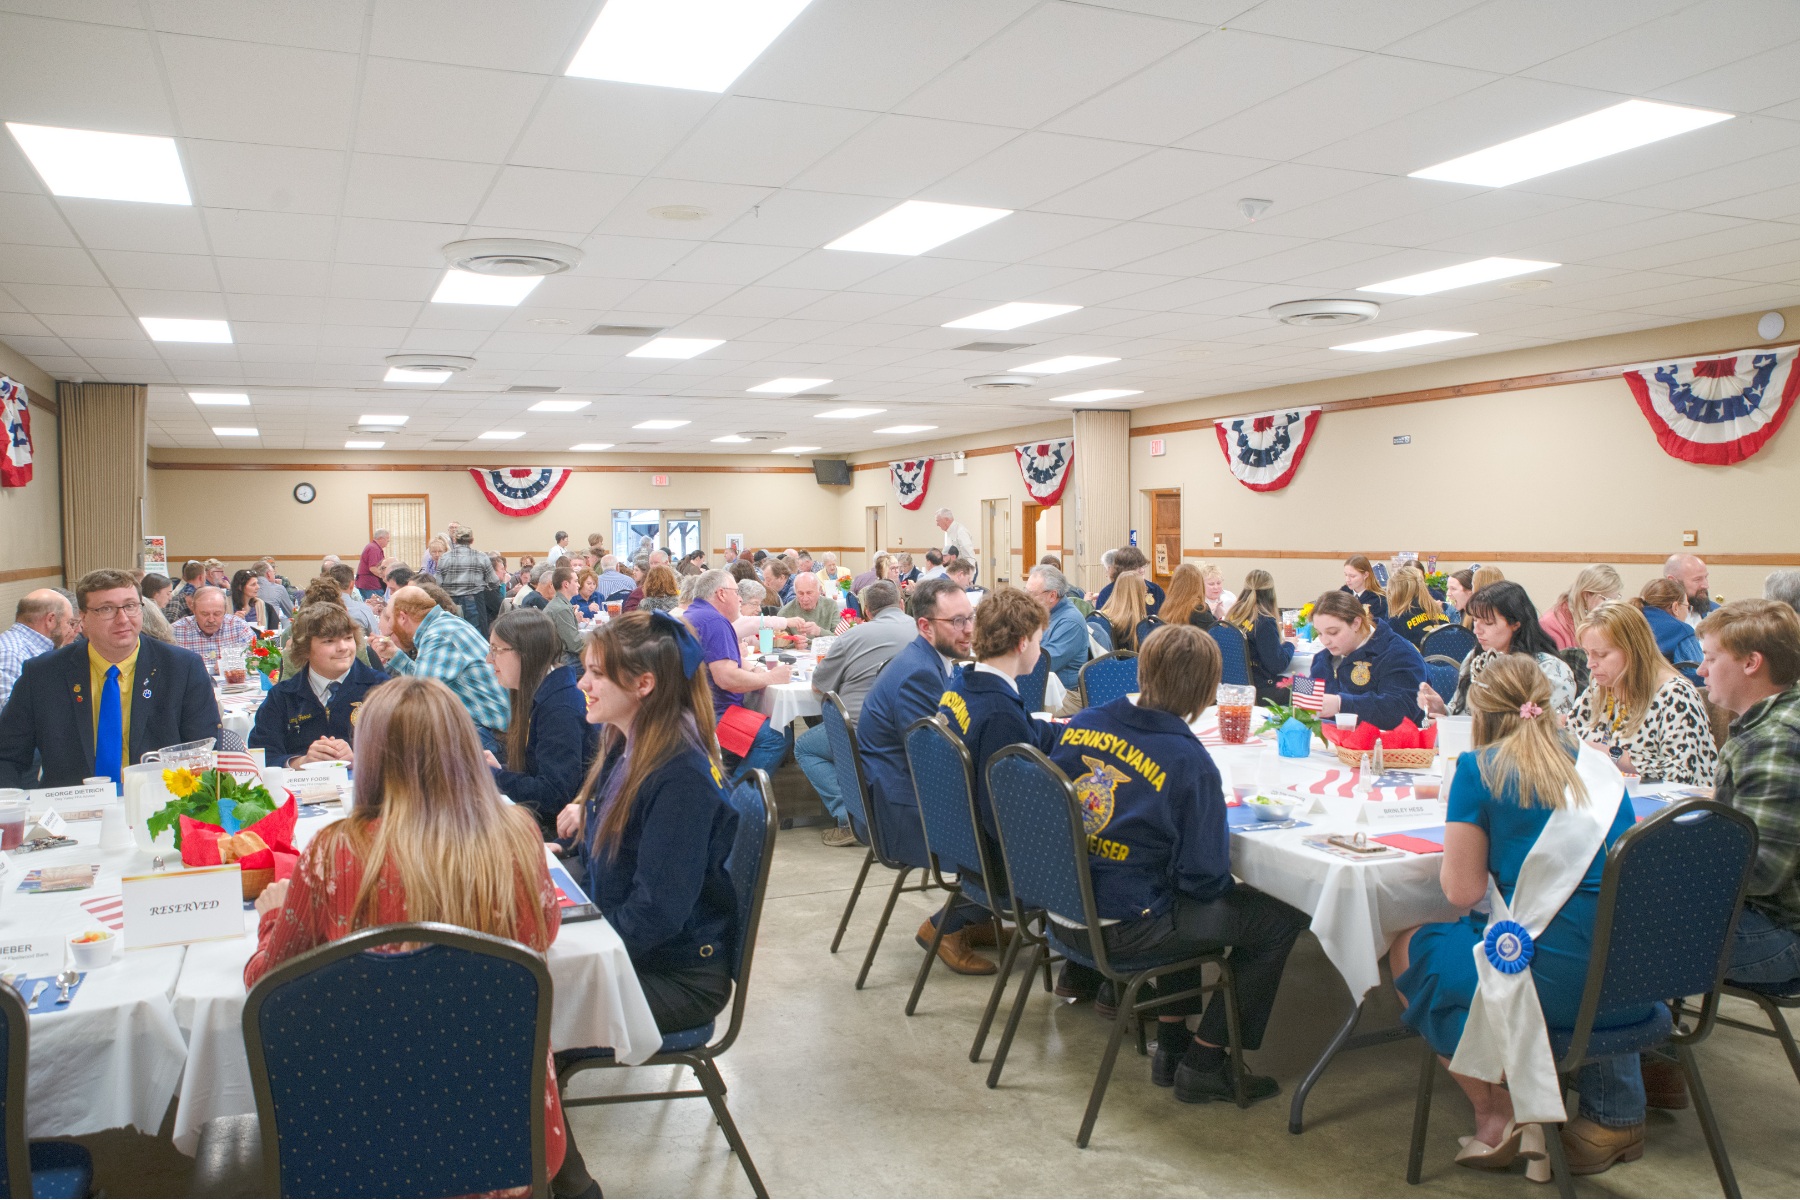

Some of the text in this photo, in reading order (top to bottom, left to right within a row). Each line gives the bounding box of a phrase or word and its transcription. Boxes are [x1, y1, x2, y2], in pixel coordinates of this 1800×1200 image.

[1060, 727, 1167, 792] PENNSYLVANIA
[45, 790, 73, 798] GEORGE
[149, 900, 220, 916] RESERVED
